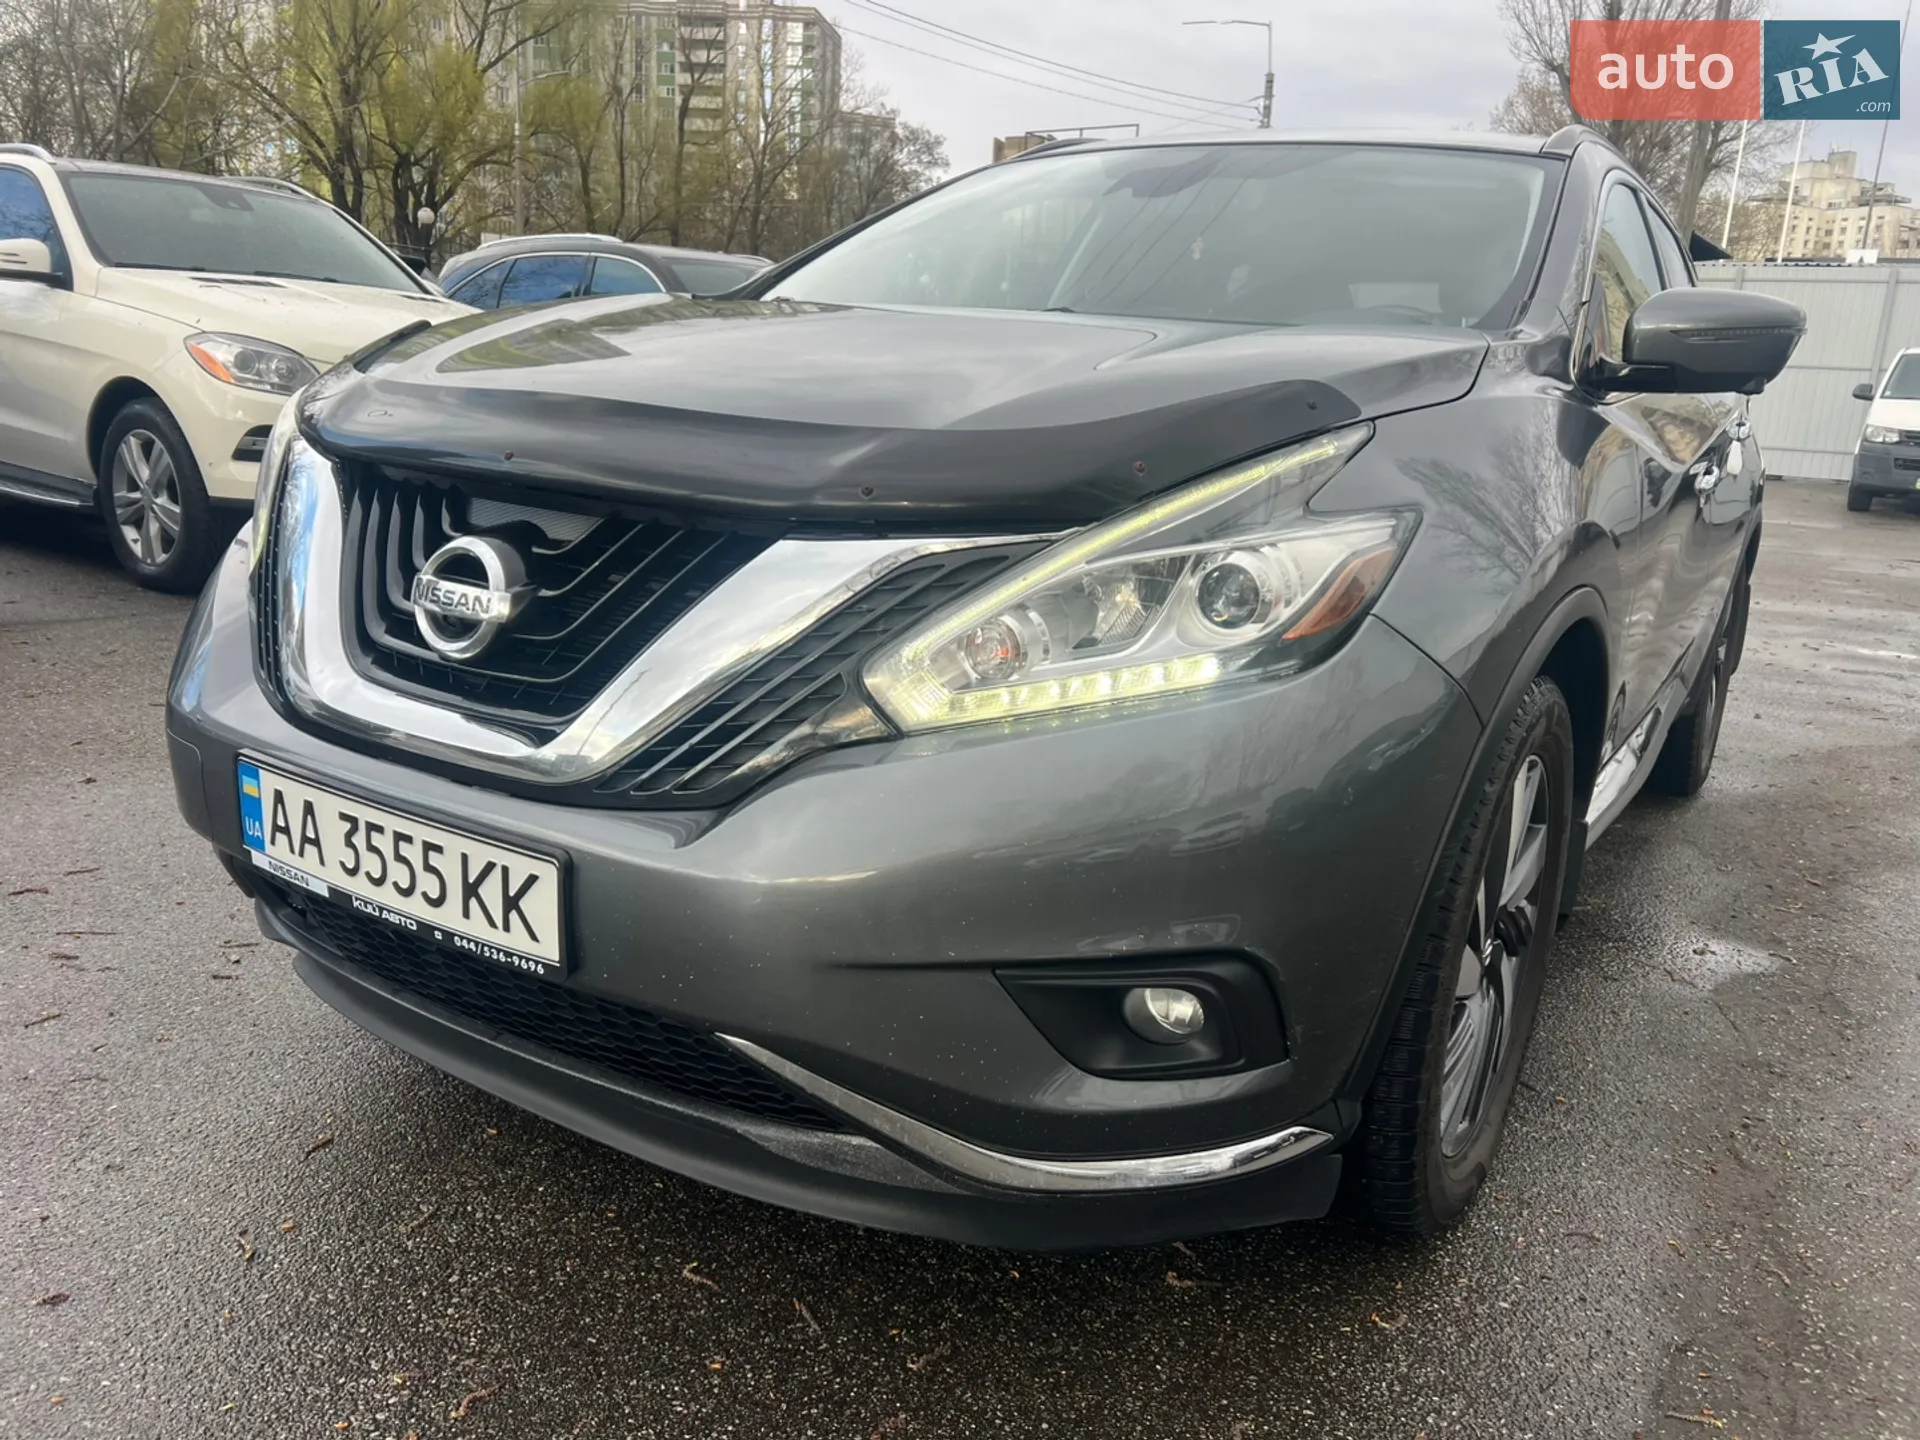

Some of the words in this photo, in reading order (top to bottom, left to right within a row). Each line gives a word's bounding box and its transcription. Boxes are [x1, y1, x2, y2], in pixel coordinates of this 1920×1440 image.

[412, 577, 491, 614] NISSAN
[244, 818, 262, 840] UA
[268, 860, 310, 887] NISSAN
[270, 787, 325, 867] AA
[338, 812, 447, 908] 3555
[461, 851, 540, 943] KK
[454, 935, 545, 975] 044/536-9696
